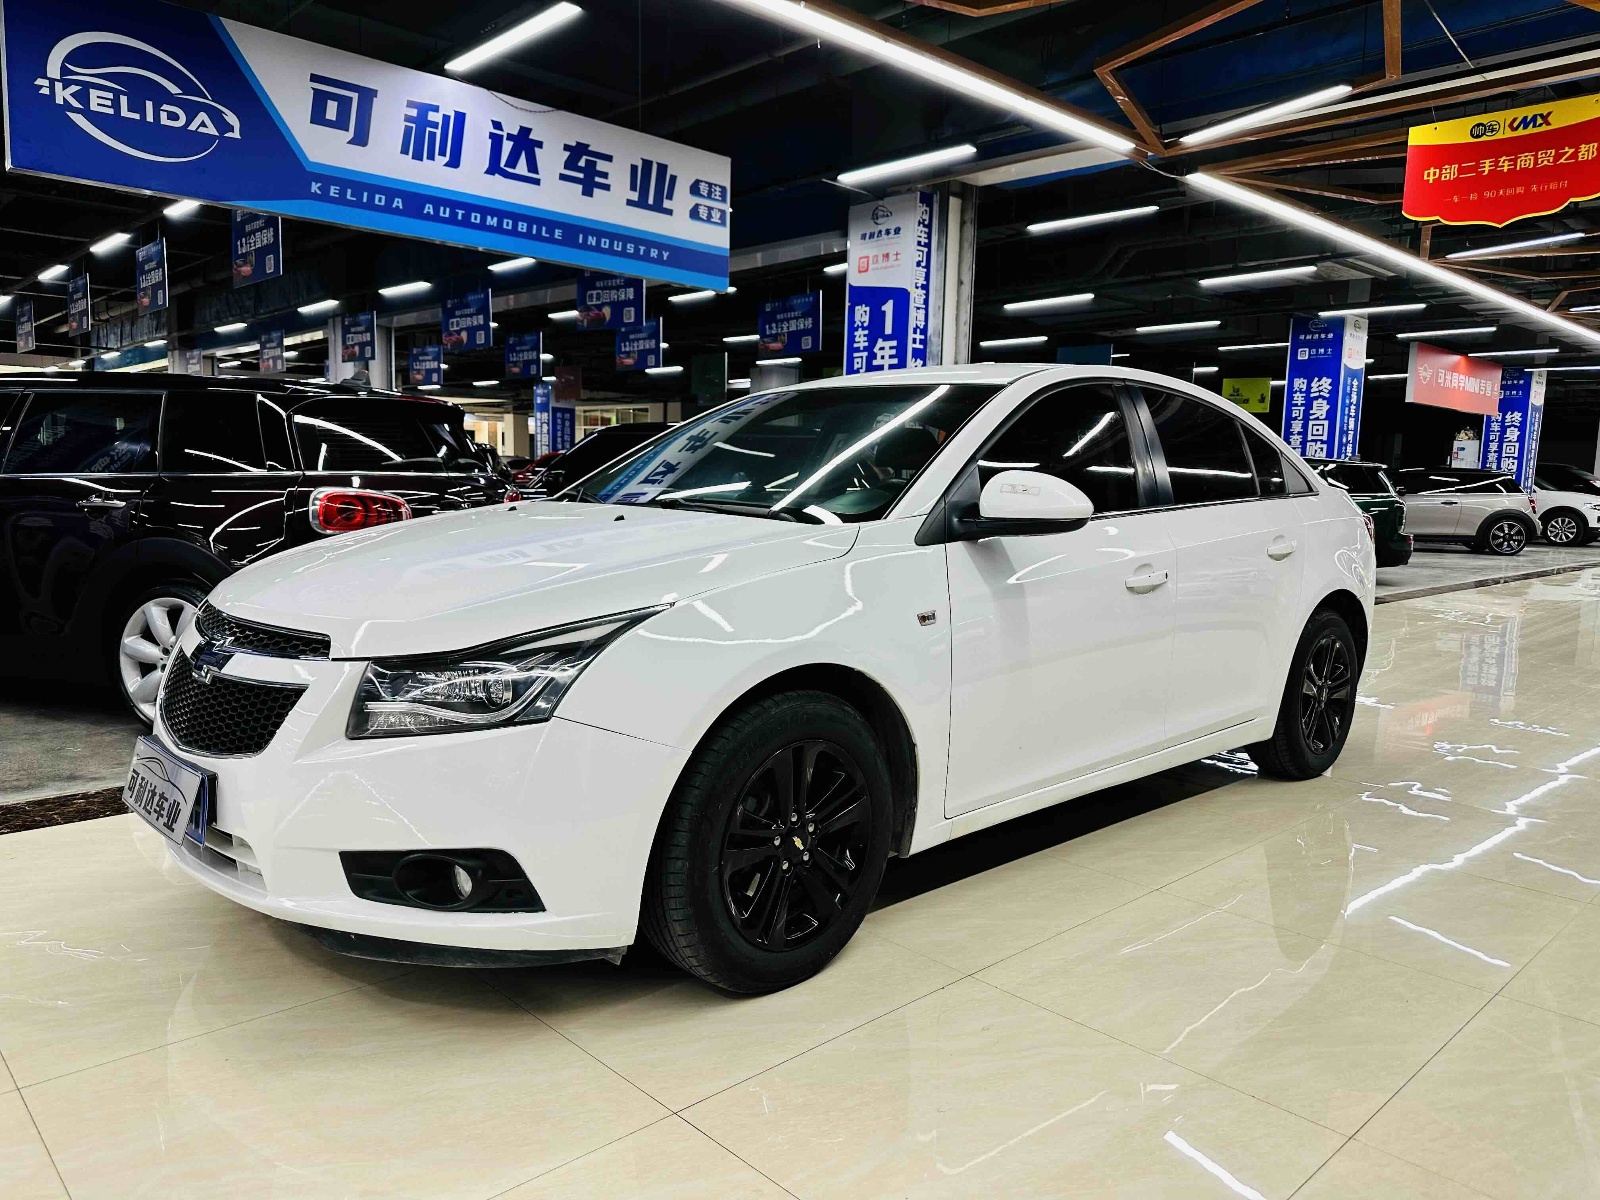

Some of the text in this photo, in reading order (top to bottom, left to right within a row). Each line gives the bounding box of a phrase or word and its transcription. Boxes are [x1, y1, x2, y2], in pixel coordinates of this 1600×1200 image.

[54, 81, 220, 136] KELIDA
[308, 72, 677, 217] 可利达车业
[1423, 142, 1598, 184] 中部二手车商贸之都
[310, 180, 672, 261] KELIDA AUTOMOBILE INDUSTRY
[697, 205, 721, 224] 专业
[698, 181, 722, 201] 专注
[853, 303, 870, 373] 购车可
[1306, 376, 1333, 458] 终身回购
[1500, 411, 1523, 473] 终身回购
[128, 768, 182, 833] 可利达车业
